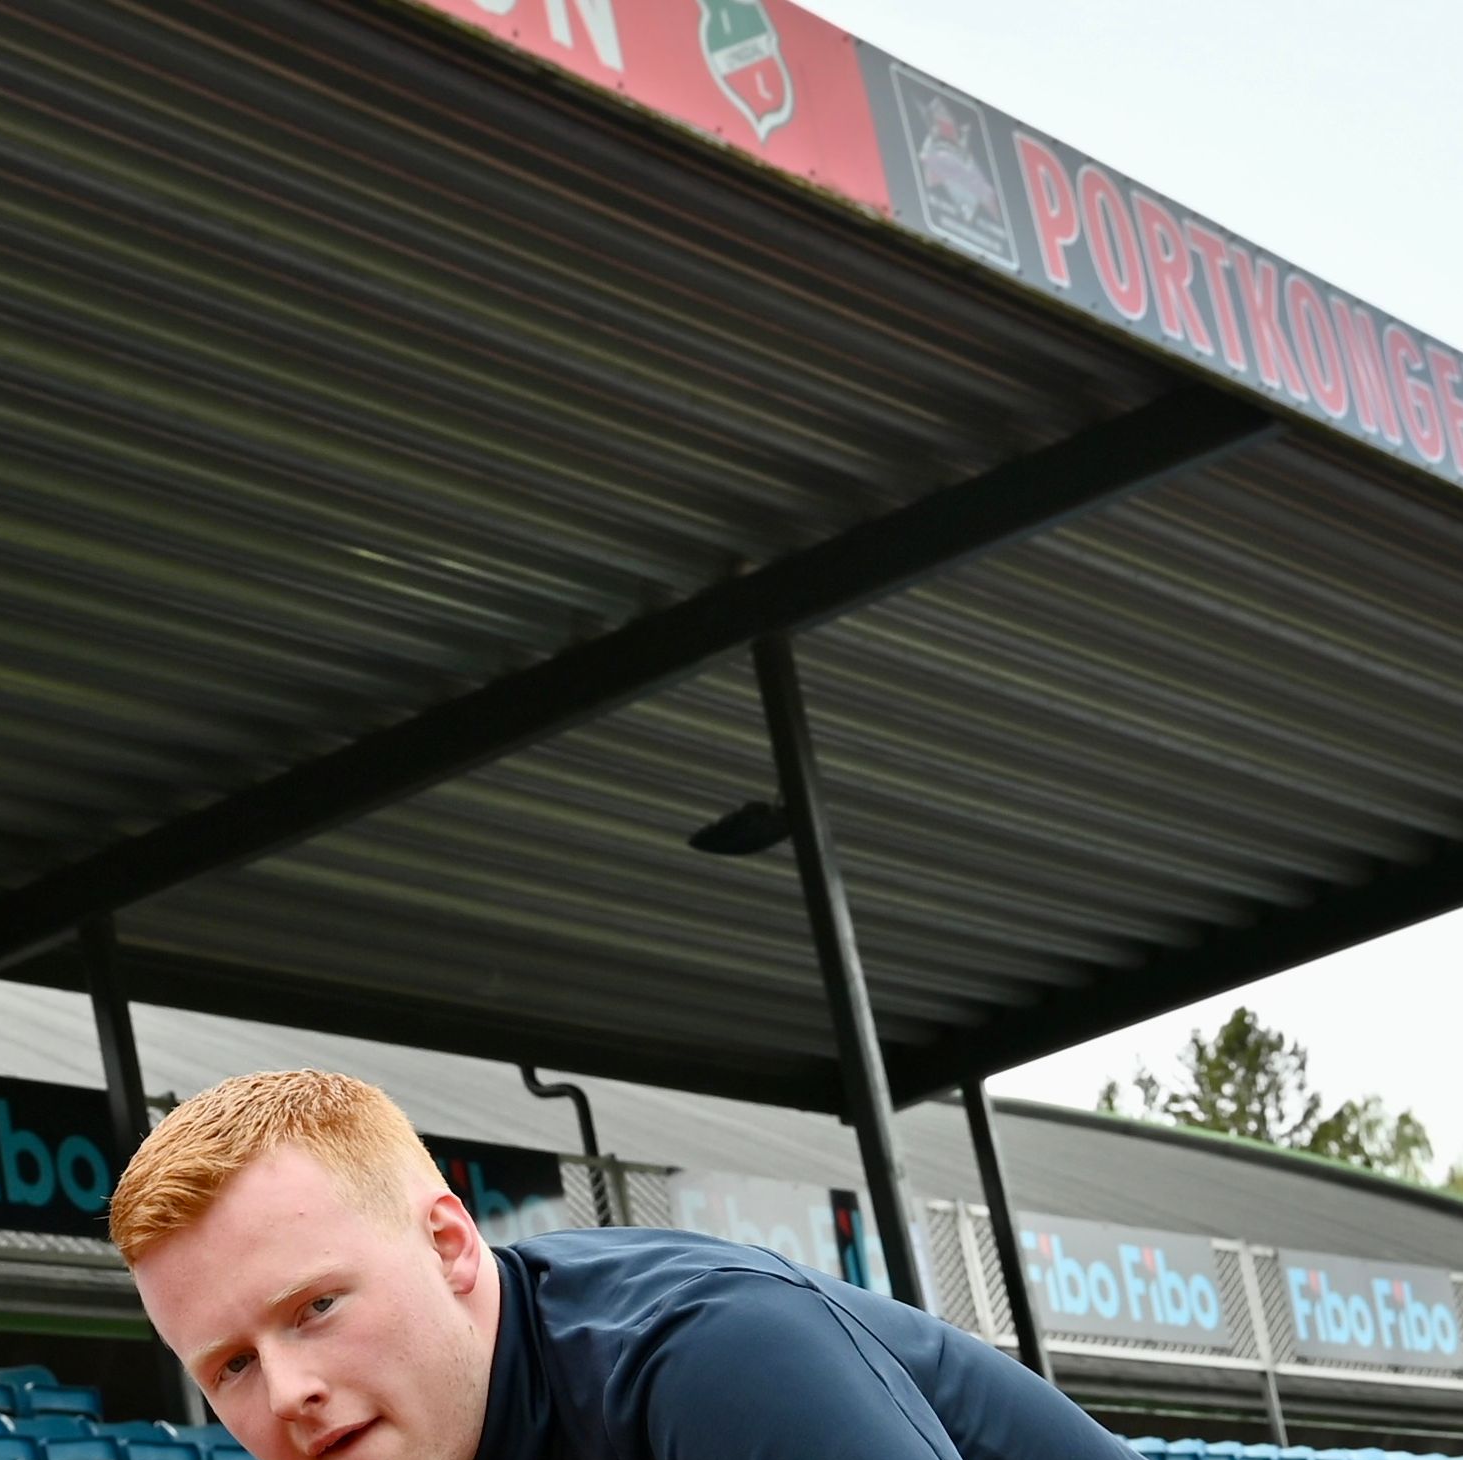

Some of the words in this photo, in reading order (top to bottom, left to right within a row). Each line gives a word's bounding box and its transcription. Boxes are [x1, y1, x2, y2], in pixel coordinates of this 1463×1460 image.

[1117, 1243, 1220, 1330] Fibo
[1288, 1266, 1375, 1348] Fibo
[1372, 1278, 1459, 1355] Fibo
